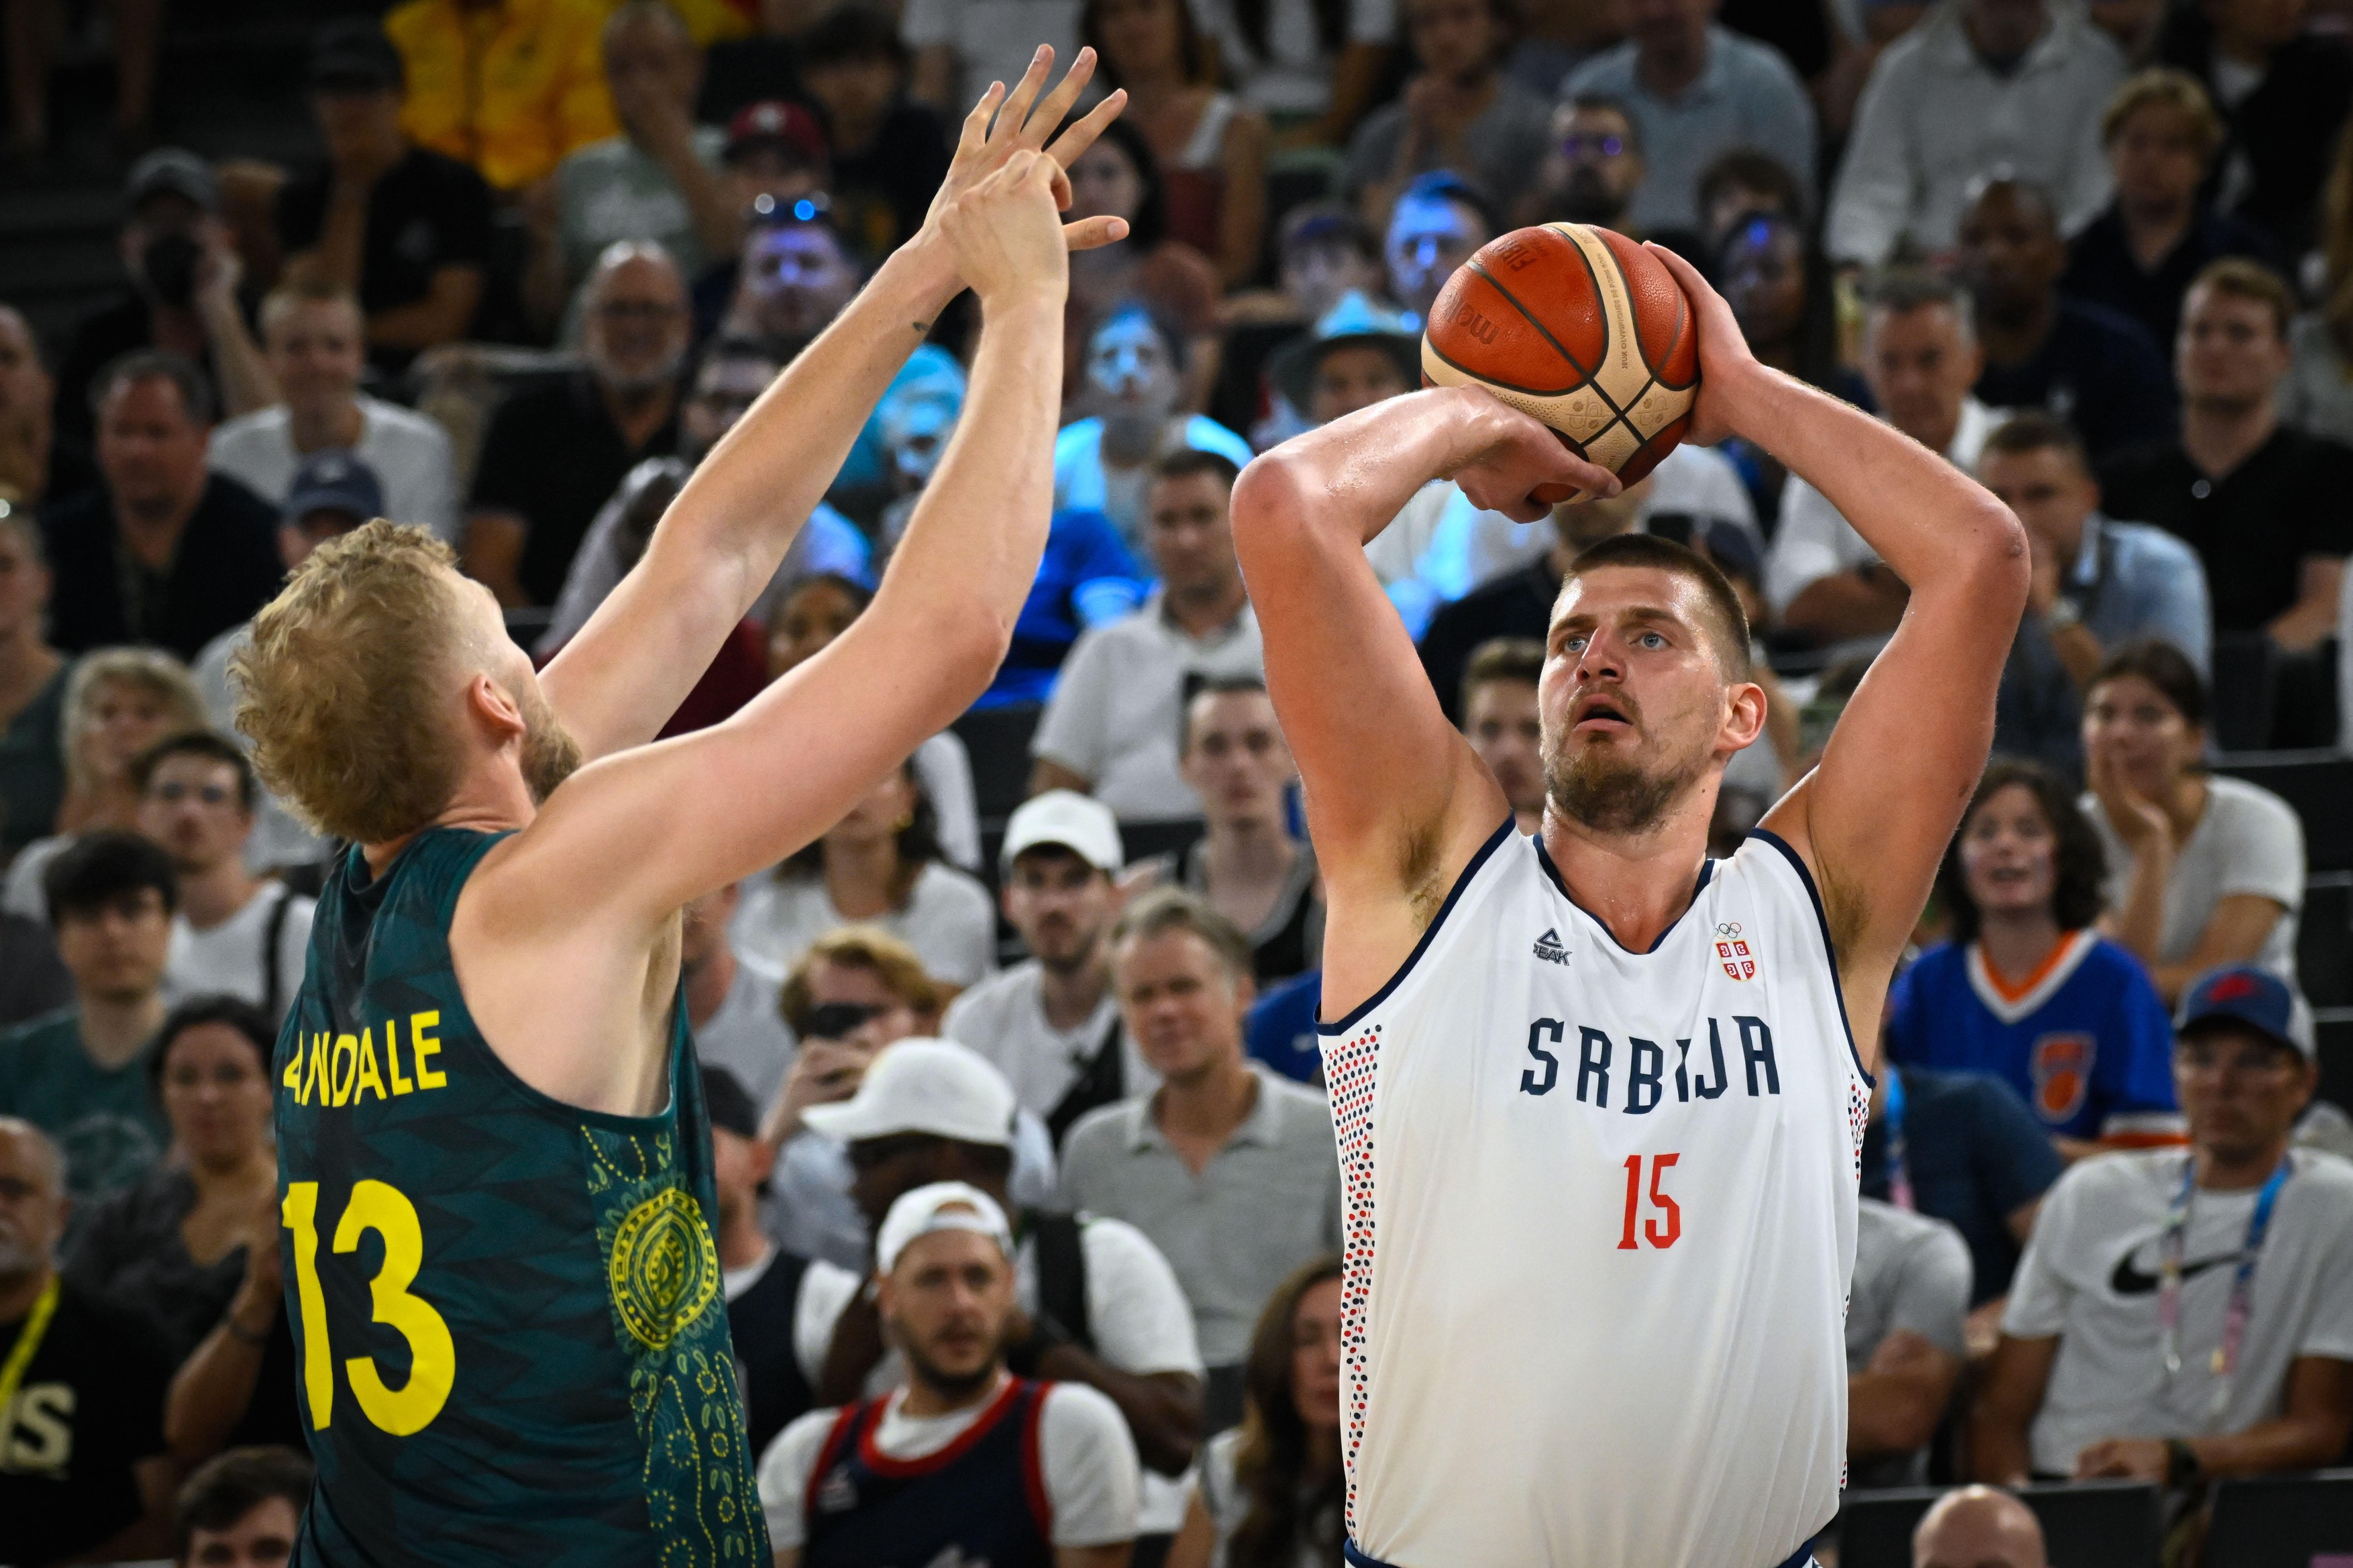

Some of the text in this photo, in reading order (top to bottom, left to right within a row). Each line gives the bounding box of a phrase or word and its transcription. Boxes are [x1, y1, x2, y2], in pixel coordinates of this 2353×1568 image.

[1520, 1016, 1780, 1114] SRBIJA
[1617, 1153, 1681, 1249] 15
[282, 1179, 456, 1436] 13
